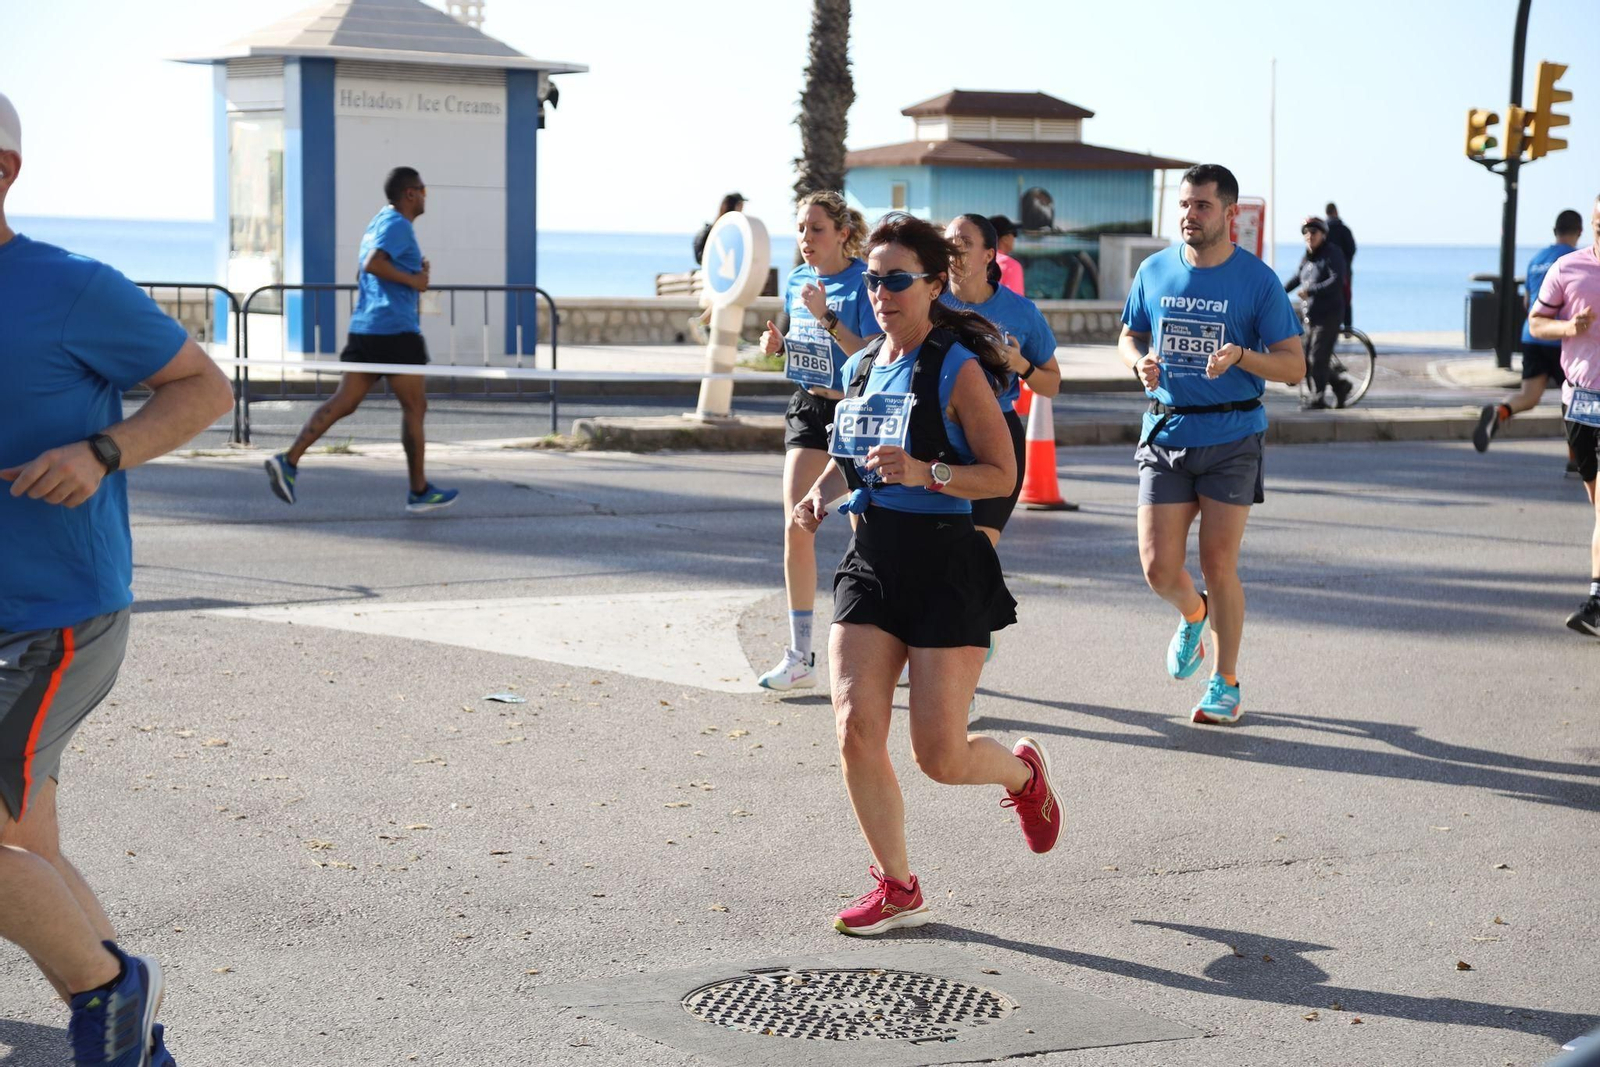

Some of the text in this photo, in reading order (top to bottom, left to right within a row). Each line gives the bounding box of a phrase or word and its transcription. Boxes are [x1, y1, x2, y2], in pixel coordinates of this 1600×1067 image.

[340, 89, 402, 110] Helados
[417, 94, 440, 112] Ice
[444, 94, 502, 115] Creams
[1160, 296, 1229, 314] mayoral
[1166, 337, 1215, 354] 1836
[793, 353, 828, 372] 1886
[842, 416, 899, 436] 2179
